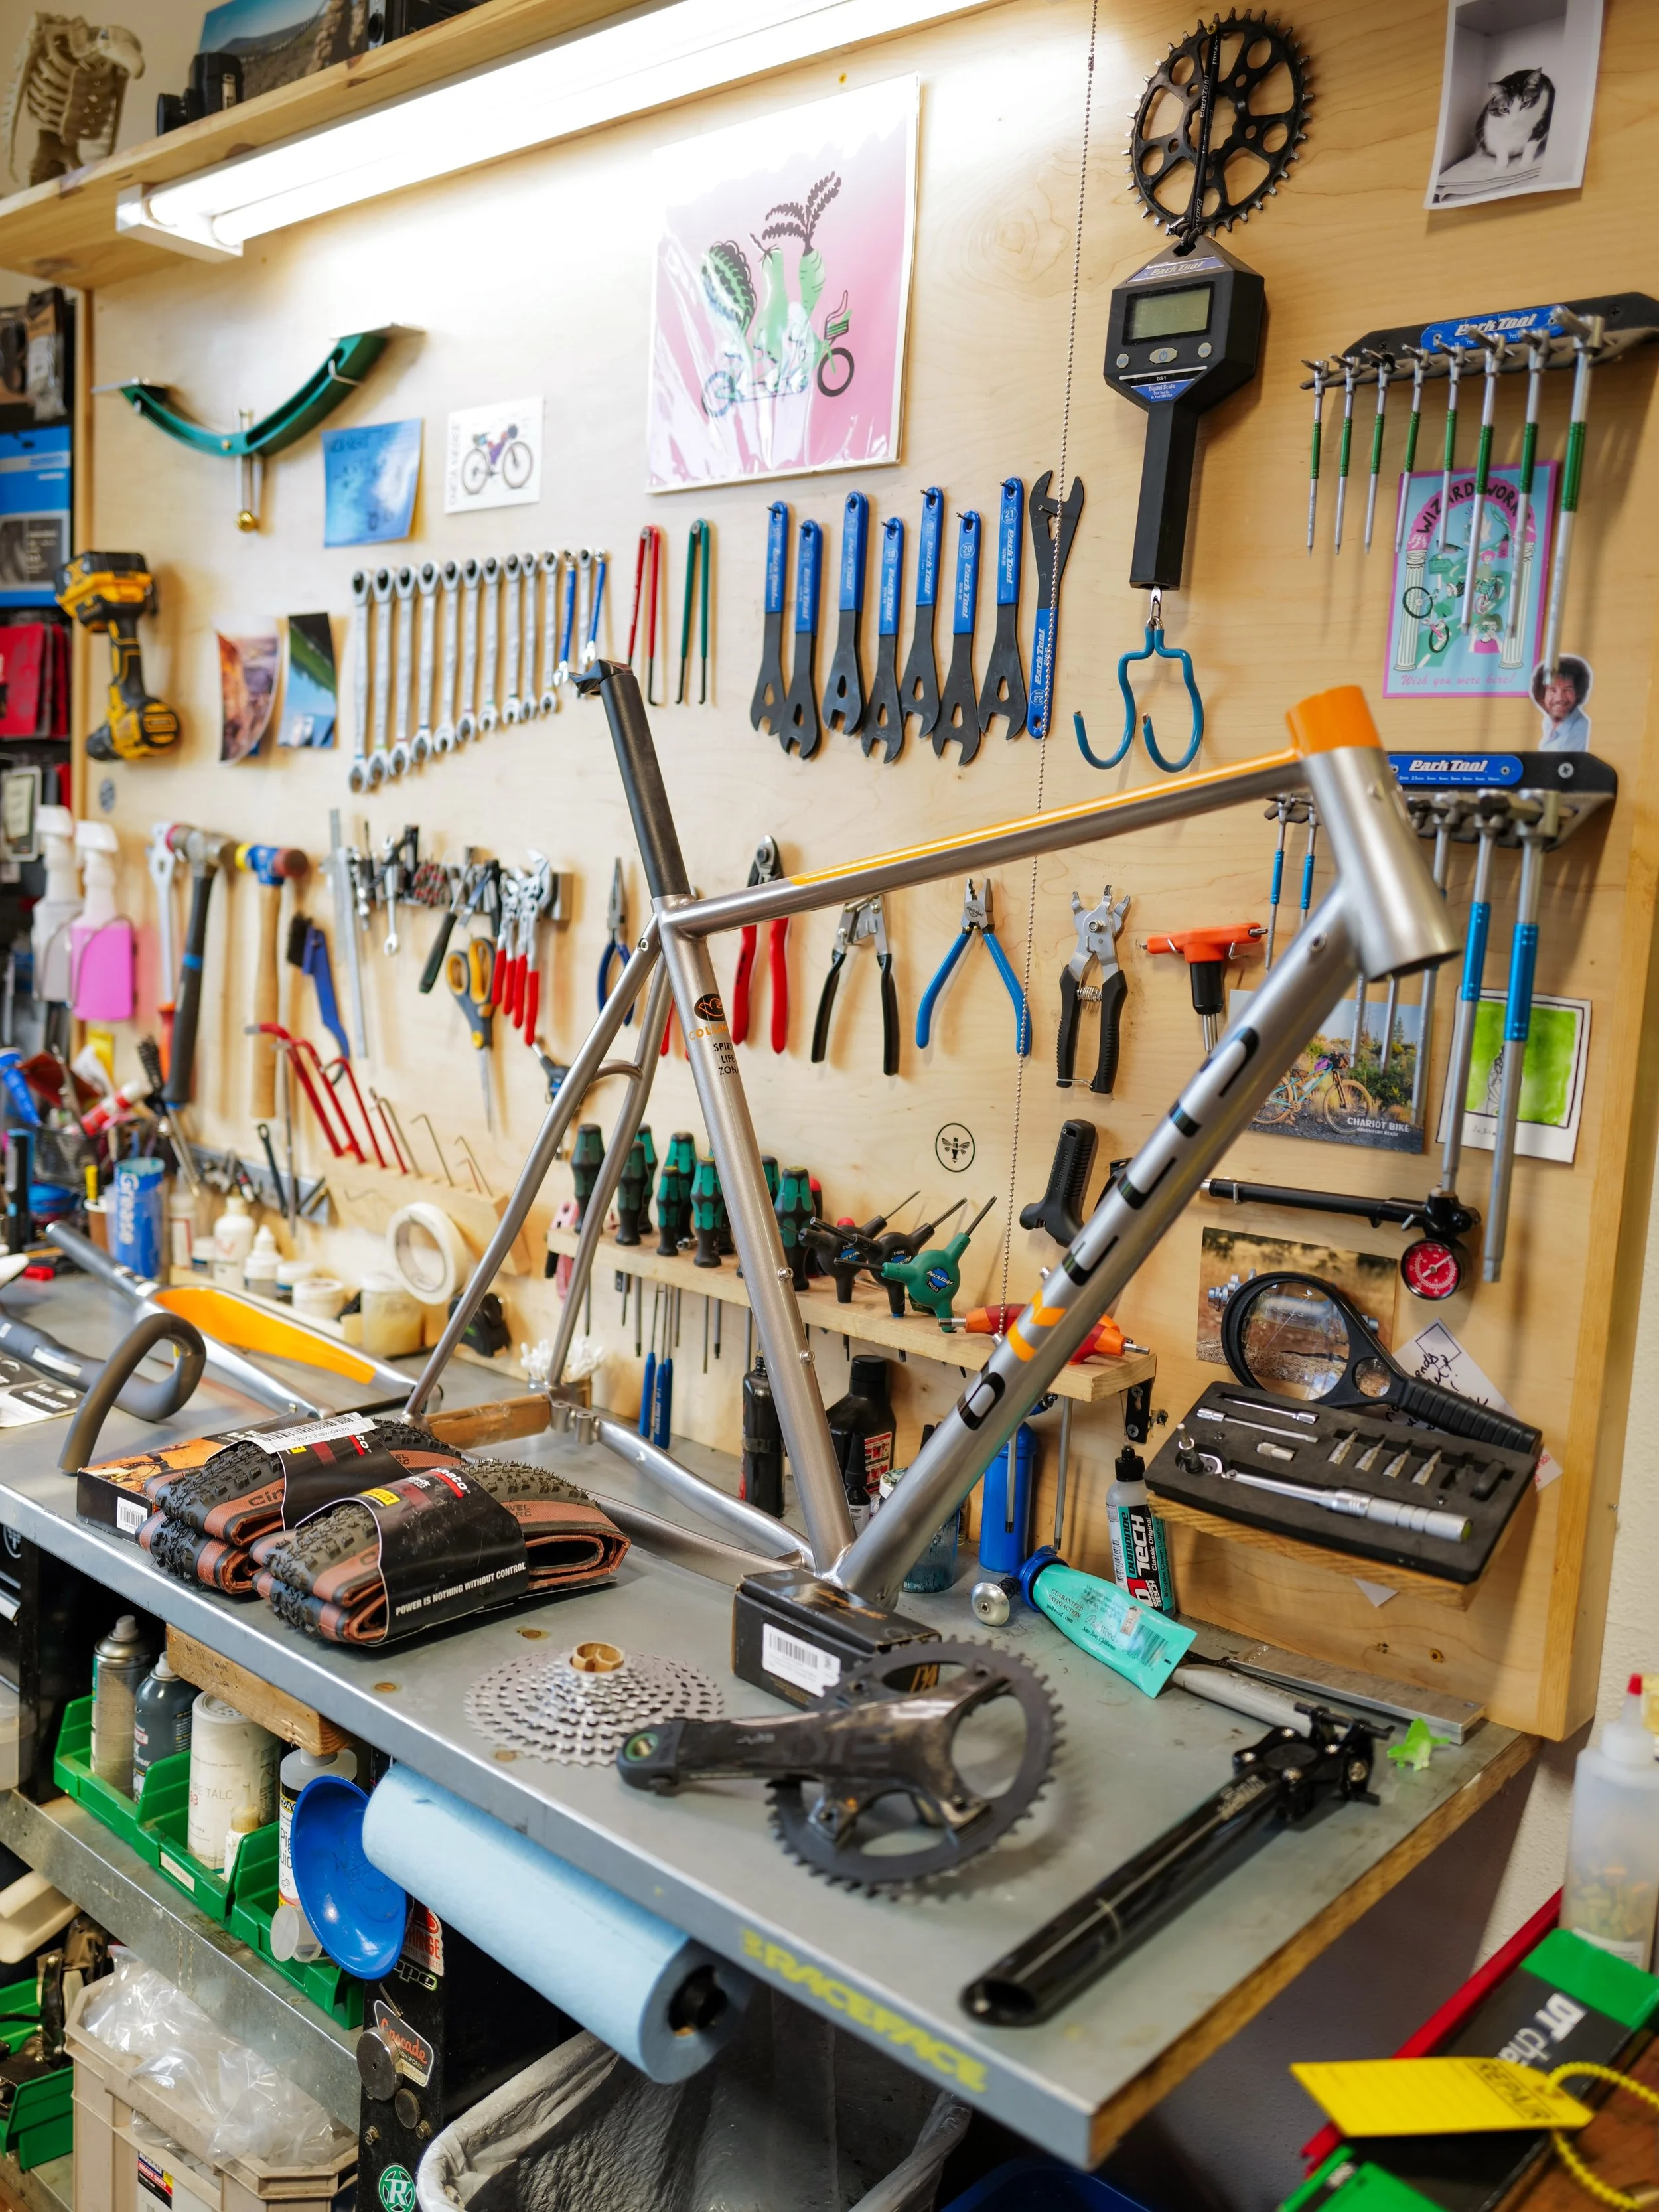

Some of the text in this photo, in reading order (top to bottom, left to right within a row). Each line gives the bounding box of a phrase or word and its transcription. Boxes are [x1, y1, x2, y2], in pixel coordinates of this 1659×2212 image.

[1150, 261, 1204, 277] Park Tool
[1454, 313, 1538, 336] Park Tool
[962, 591, 970, 619] Tool
[1035, 628, 1045, 685] Park Tool
[1401, 672, 1516, 690] Wish you were here!
[1034, 695, 1044, 703] 23
[1409, 759, 1488, 772] Park Tool
[721, 1055, 735, 1063] LIFE
[1347, 1117, 1410, 1132] CHARIOT BIKE
[1055, 1150, 1068, 1189] SHIMANO
[926, 1270, 954, 1286] Park Tool
[928, 1281, 939, 1293] TWS-3
[291, 1426, 350, 1443] REMOVABLE LABEL
[1145, 1517, 1157, 1571] Classic Original
[396, 1561, 526, 1617] POWER IS NOTHING WITHOUT CONTROL
[1048, 1594, 1082, 1618] SATISFACTION
[1051, 1589, 1084, 1611] GUARANTEED
[1101, 1625, 1116, 1641] Wood
[1099, 1637, 1116, 1651] California
[206, 1787, 232, 1800] TALC
[1534, 1993, 1586, 2043] DT
[380, 2018, 428, 2065] Cascade
[409, 2055, 423, 2070] WORKS
[1480, 2063, 1551, 2119] REPAIR
[139, 2162, 154, 2179] HEAVY
[153, 2174, 167, 2188] DUTY
[389, 2179, 407, 2205] R
